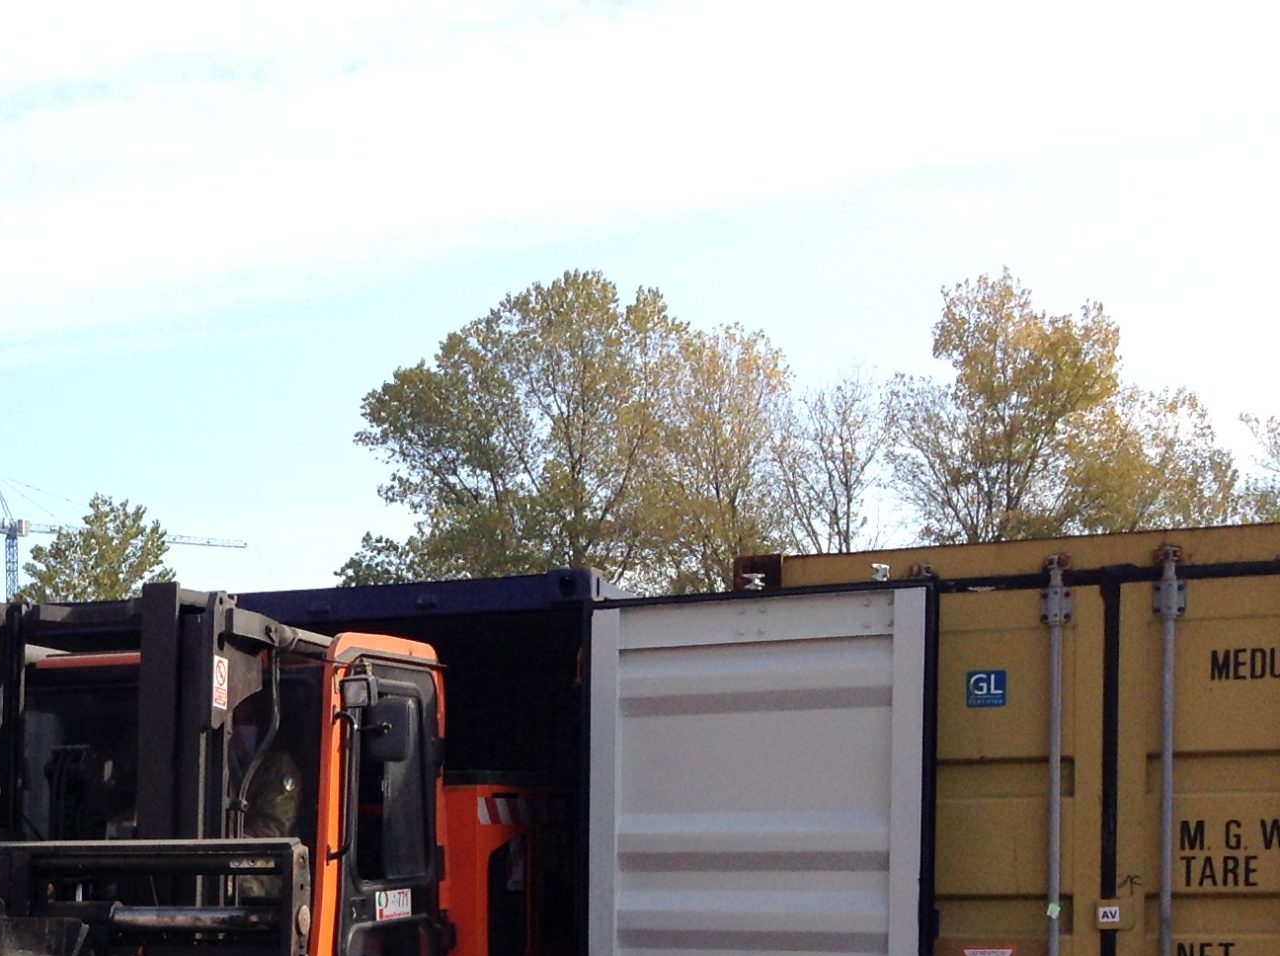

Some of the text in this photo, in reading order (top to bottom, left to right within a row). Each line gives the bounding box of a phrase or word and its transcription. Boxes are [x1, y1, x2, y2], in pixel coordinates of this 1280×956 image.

[970, 673, 1004, 695] GL
[1180, 855, 1259, 888] TARE
[1101, 910, 1118, 920] AV
